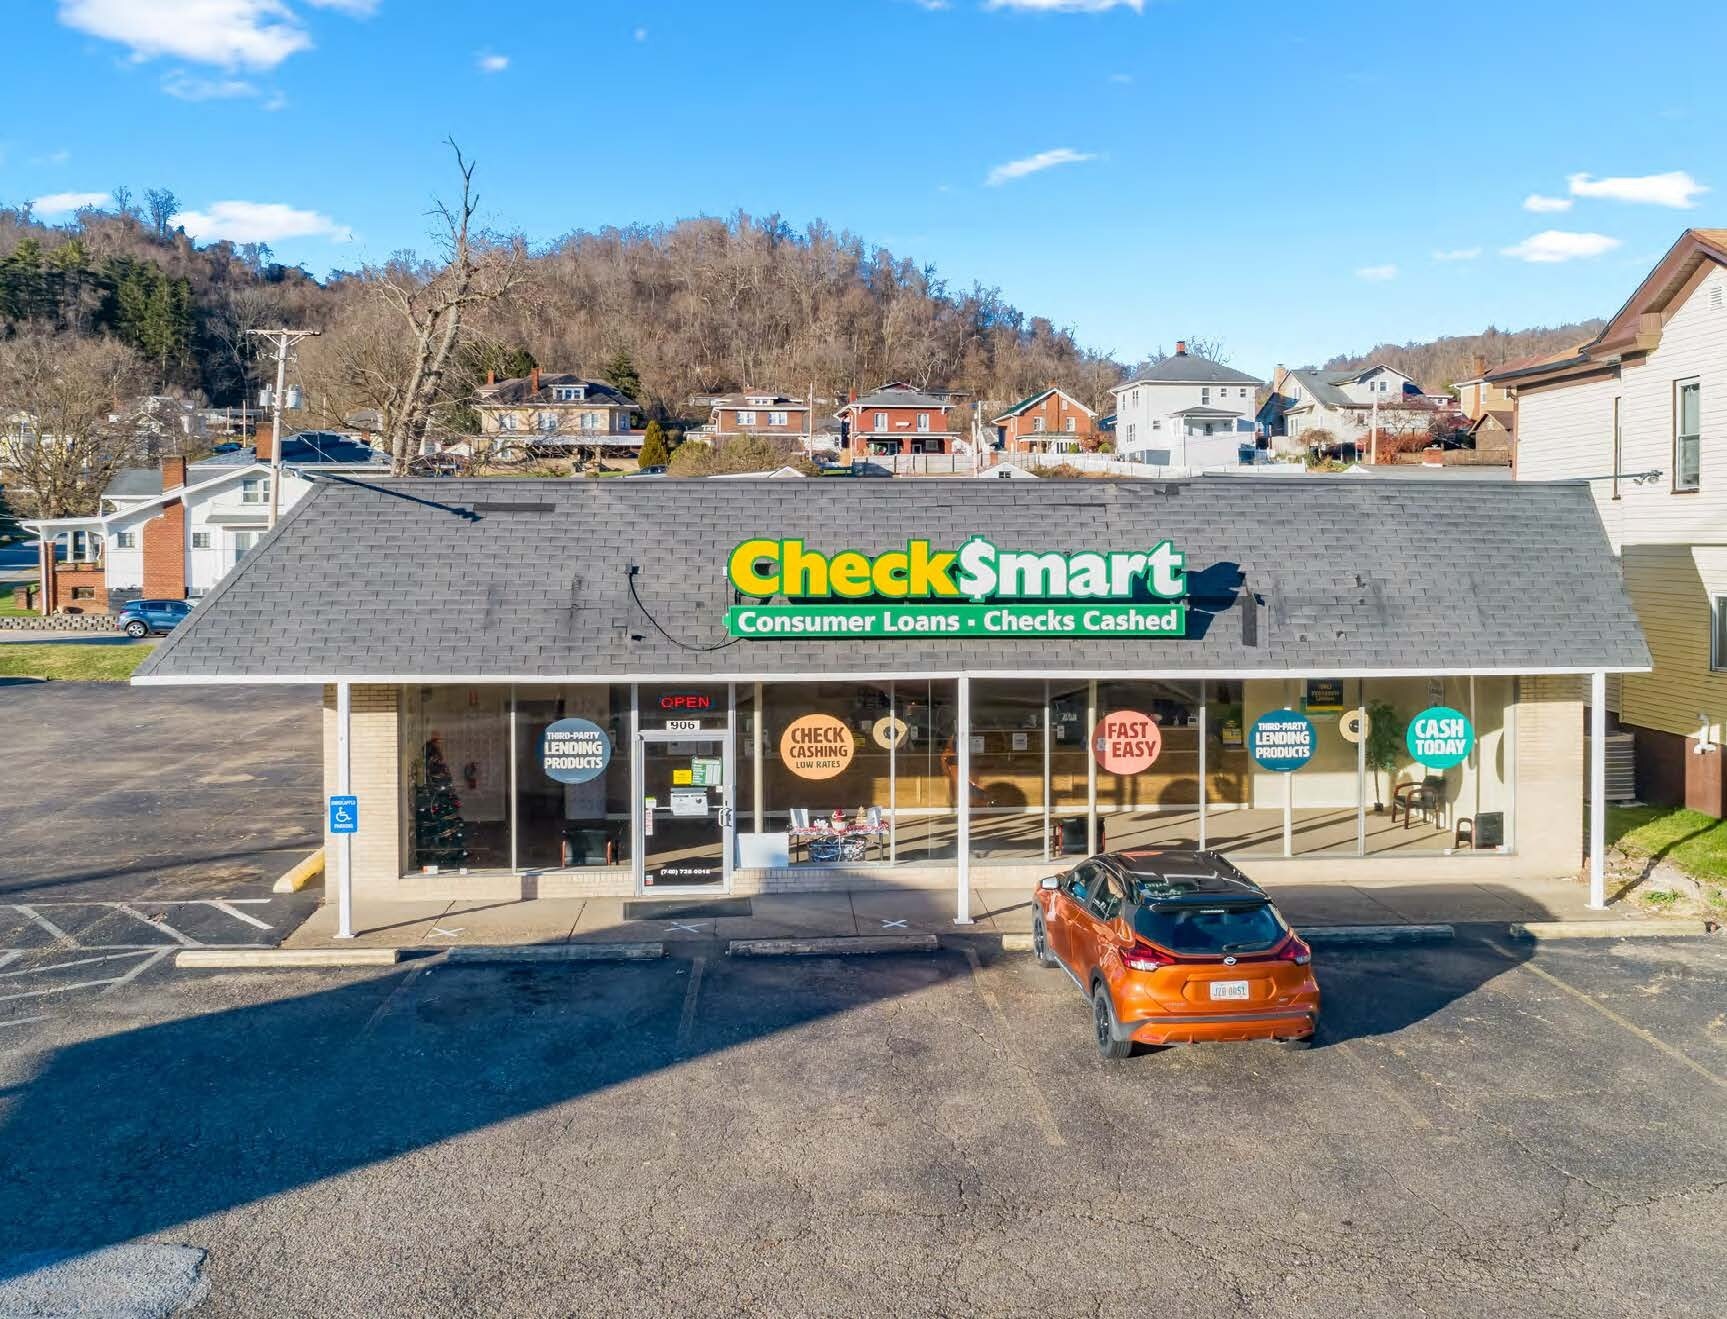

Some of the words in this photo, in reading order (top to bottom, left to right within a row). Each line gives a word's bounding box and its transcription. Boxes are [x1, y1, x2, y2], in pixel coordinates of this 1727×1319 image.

[738, 610, 878, 632] Consumer
[884, 611, 959, 632] Loans
[984, 609, 1075, 632] Checks
[1082, 609, 1177, 631] Cashed
[661, 697, 709, 708] OPEN
[671, 721, 695, 729] 906
[1108, 722, 1148, 738] FAST
[1258, 722, 1307, 730] THIRD-PARTY
[1415, 719, 1464, 738] CASH
[791, 727, 844, 744] CHECK
[1256, 731, 1309, 745] LENDING
[544, 741, 602, 754] LENDING
[789, 745, 848, 758] CASHING
[1112, 741, 1156, 757] EASY
[1256, 746, 1309, 758] PRODUCTS
[1416, 739, 1466, 755] TODAY
[544, 757, 602, 768] PRODUCTS
[796, 761, 813, 769] LOW
[816, 760, 840, 768] RATES
